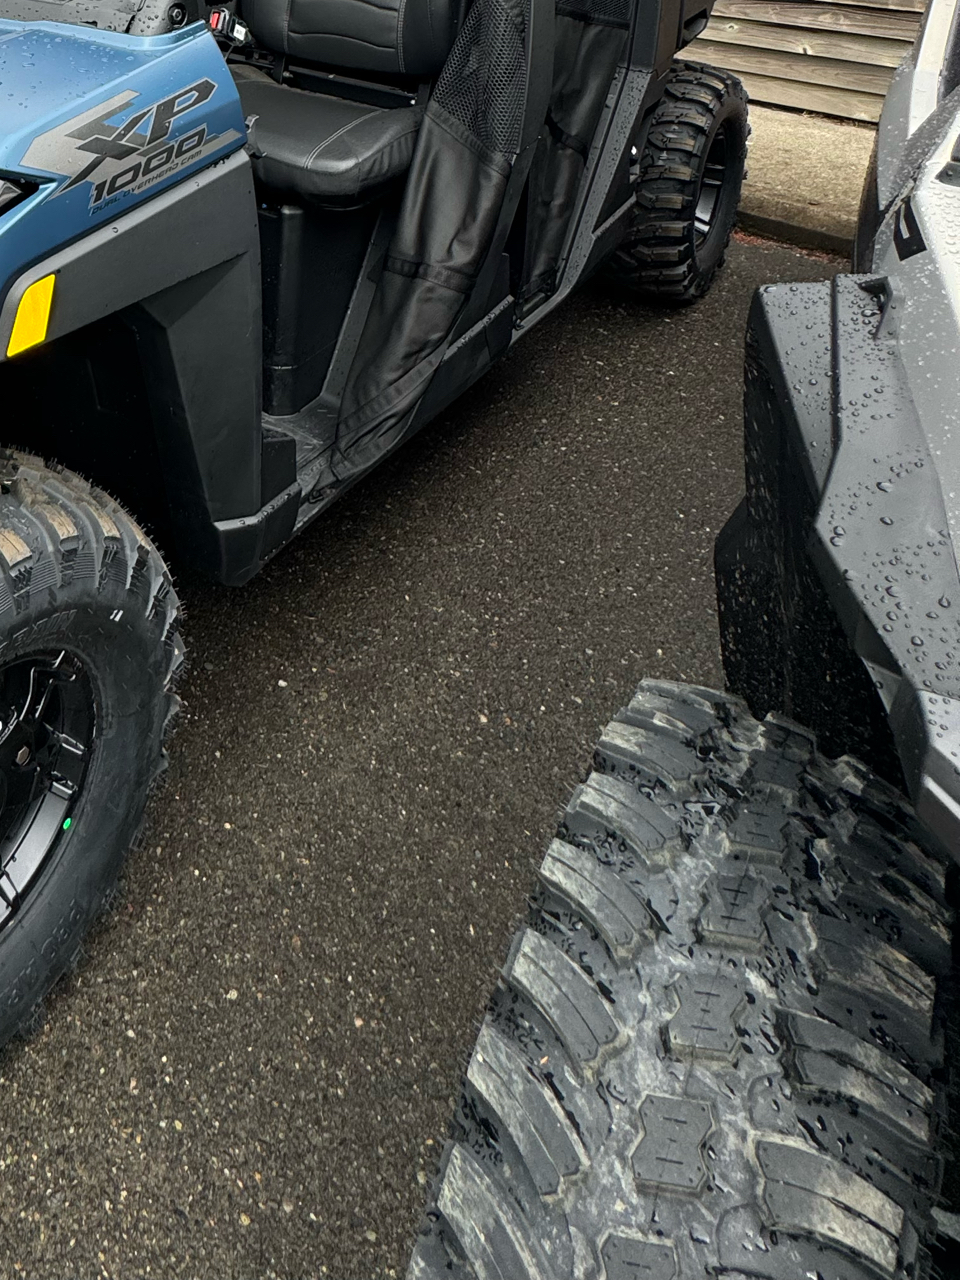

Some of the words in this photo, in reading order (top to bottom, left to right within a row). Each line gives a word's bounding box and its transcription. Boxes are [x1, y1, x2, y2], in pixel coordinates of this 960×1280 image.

[56, 77, 218, 195] XP
[92, 126, 207, 204] 1000
[91, 195, 120, 214] DUAL
[122, 162, 179, 198] OVERHEAD
[180, 149, 202, 166] CAM
